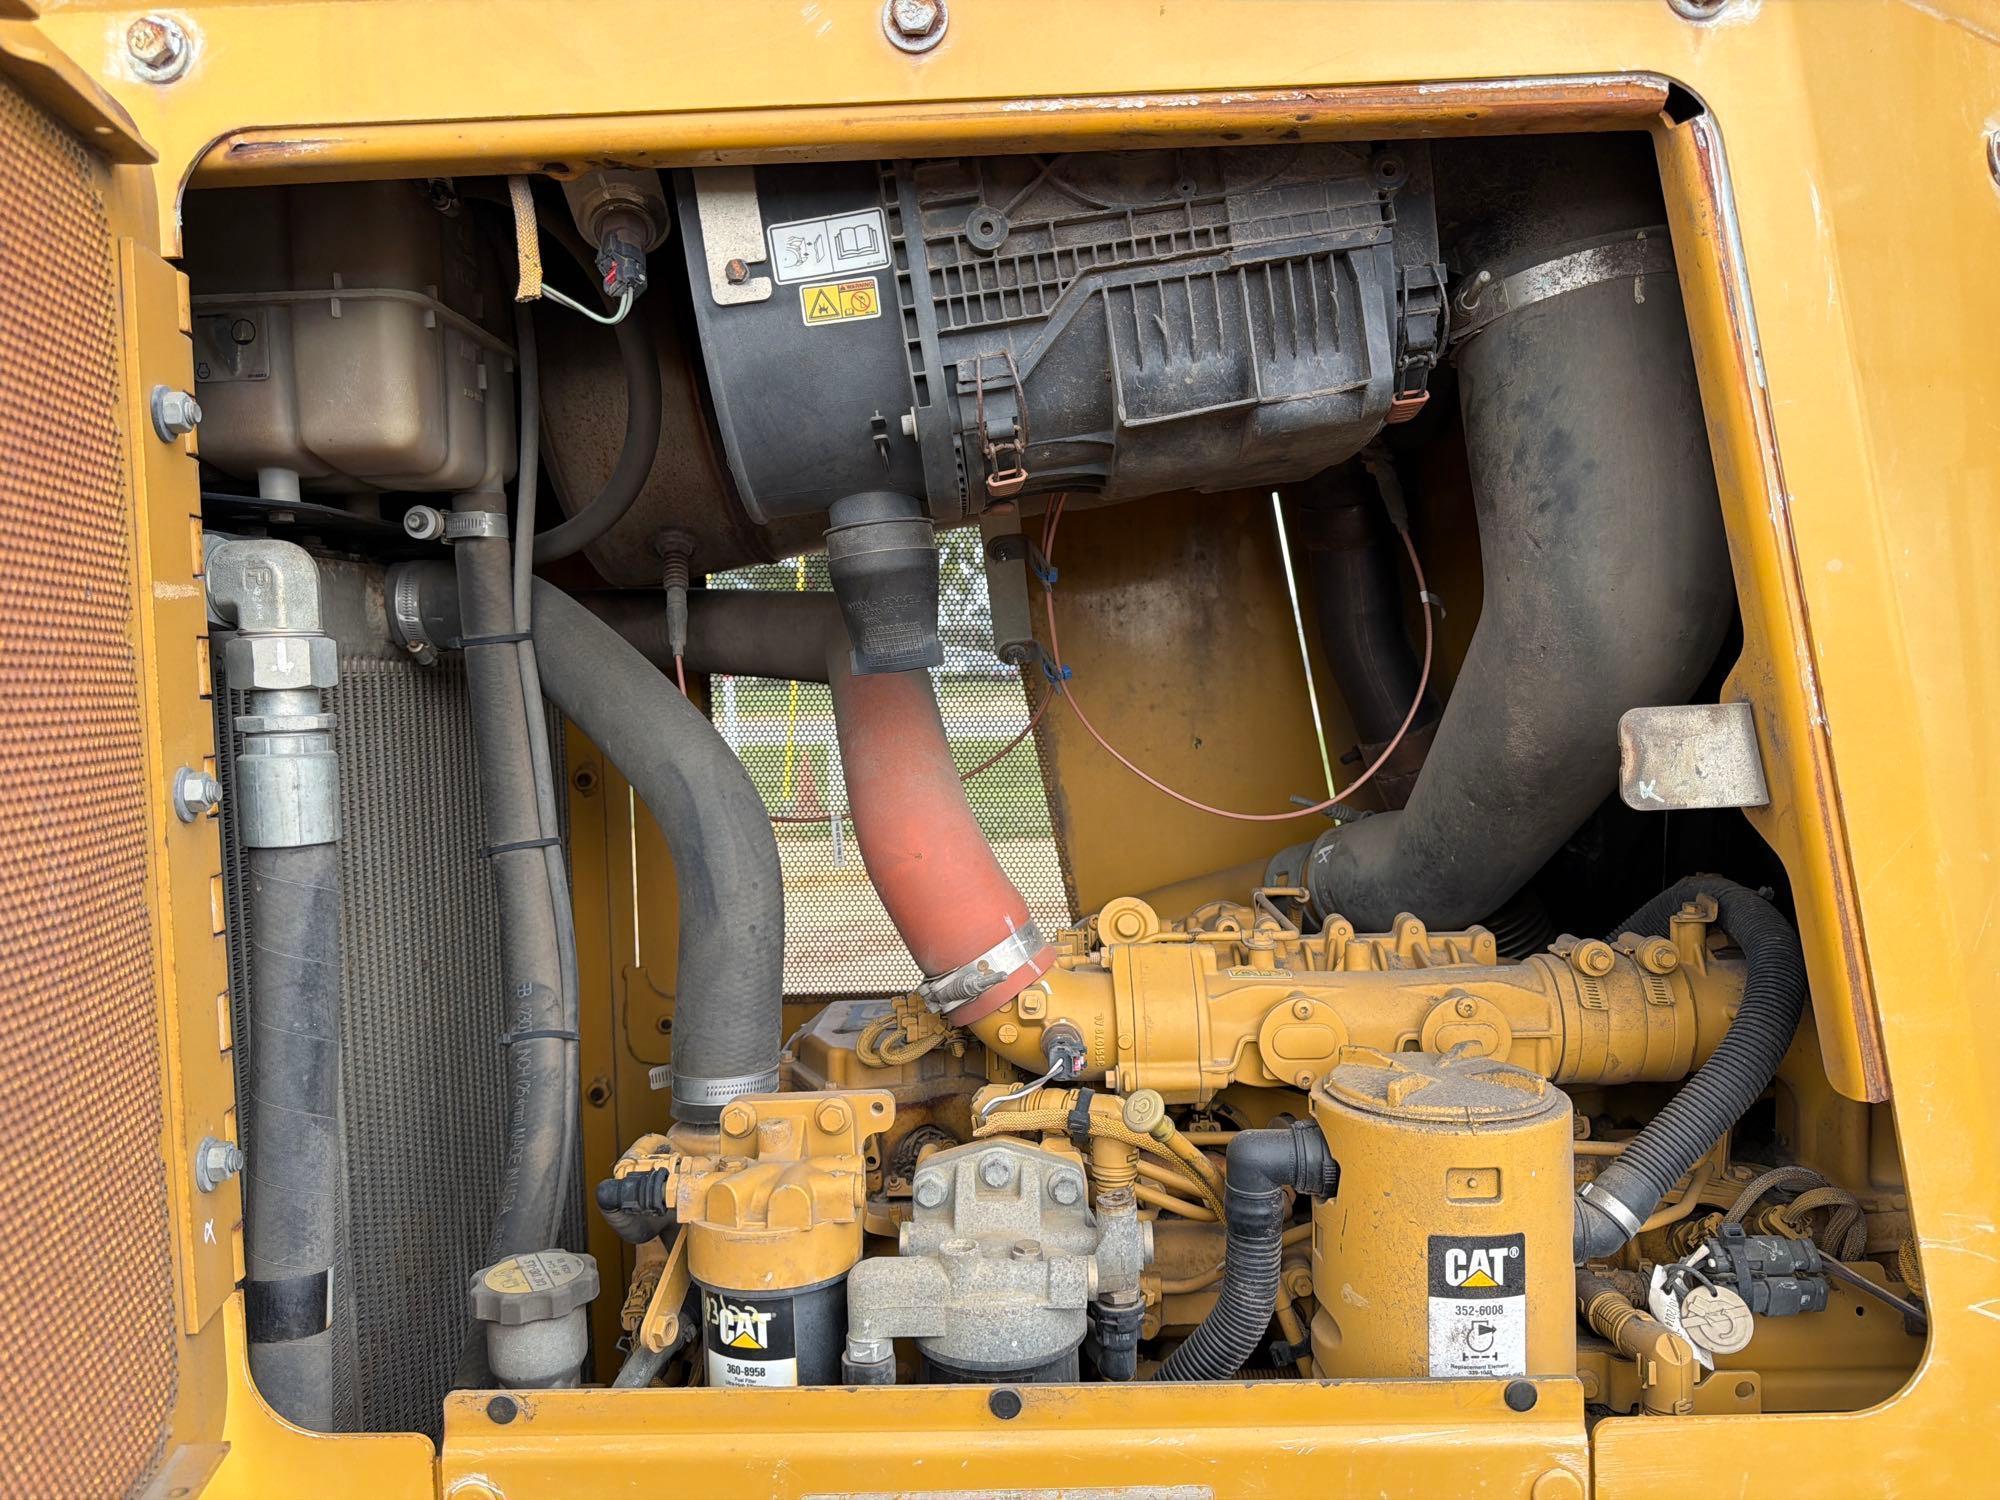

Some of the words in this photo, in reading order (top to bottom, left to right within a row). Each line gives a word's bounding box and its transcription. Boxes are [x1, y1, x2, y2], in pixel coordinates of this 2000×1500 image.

[846, 281, 874, 290] WARNING
[1455, 1305, 1504, 1316] 352-6008
[727, 1363, 766, 1377] 360-8958
